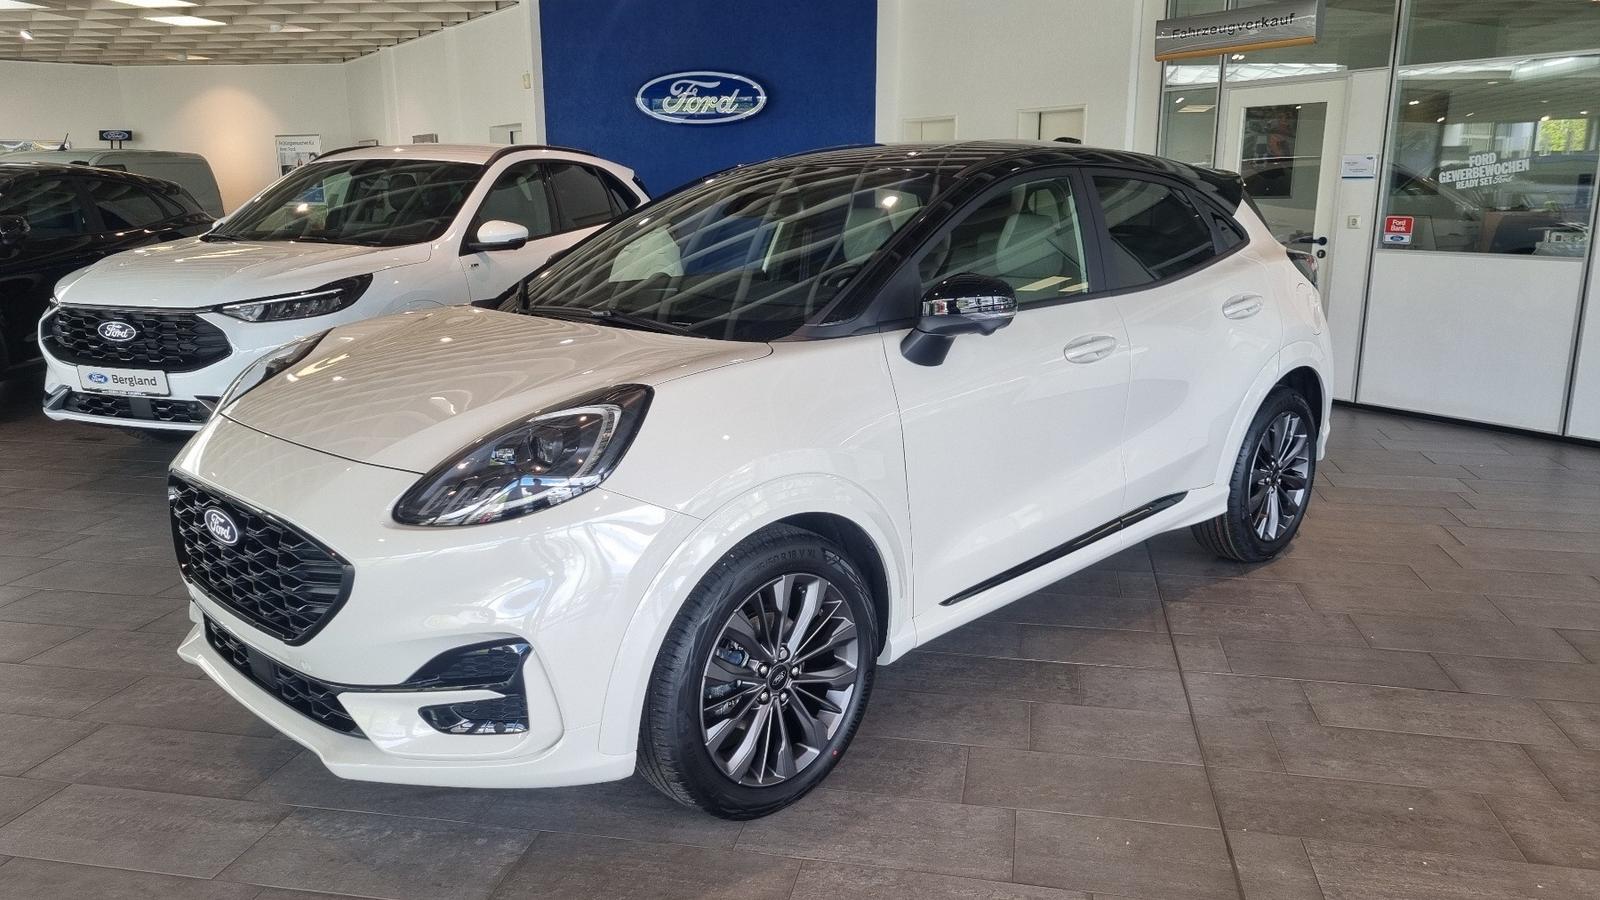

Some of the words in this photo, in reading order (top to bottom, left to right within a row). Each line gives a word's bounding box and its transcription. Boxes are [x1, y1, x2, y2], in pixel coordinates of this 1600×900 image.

[1172, 13, 1296, 40] Fahrzeugverkauf
[662, 79, 740, 114] Ford
[1469, 153, 1497, 167] FORD
[1439, 159, 1530, 184] GEWERBEWOCHEN
[1456, 179, 1479, 190] READY
[1480, 176, 1493, 187] SET
[105, 324, 128, 338] Ford
[111, 374, 158, 387] Bergland
[210, 513, 231, 540] Ford
